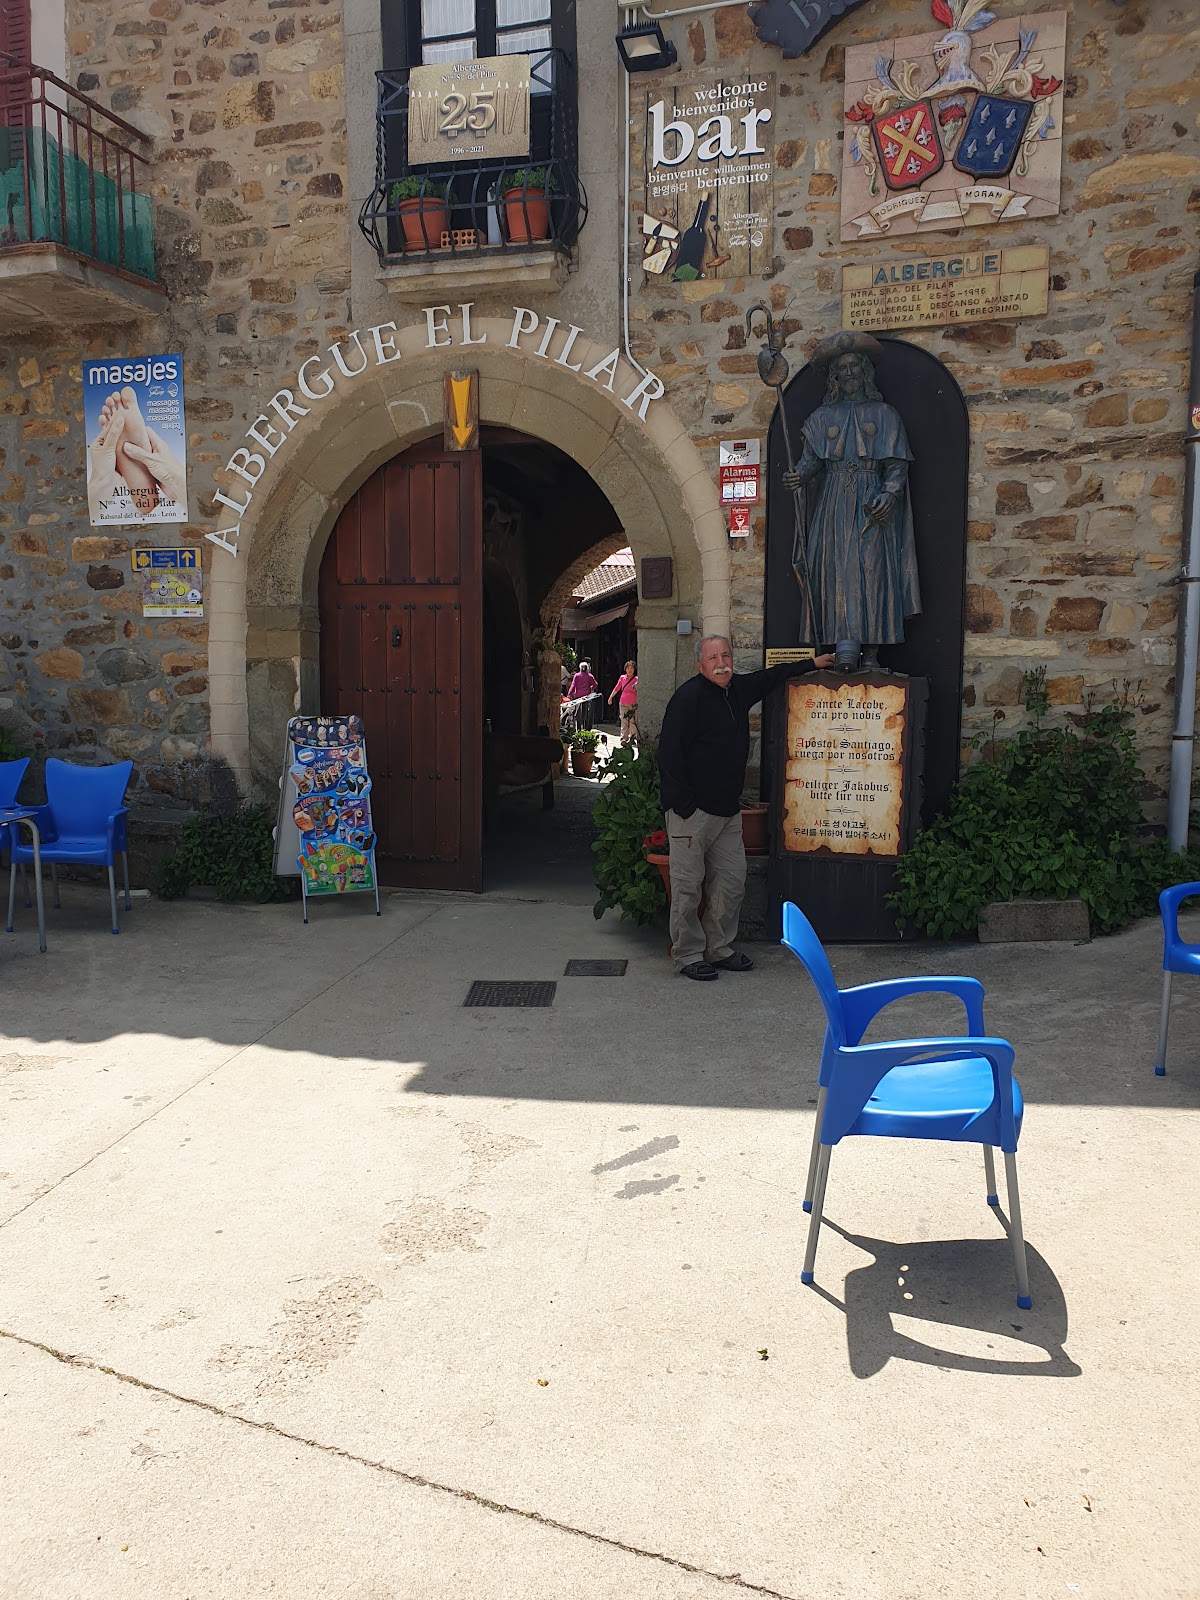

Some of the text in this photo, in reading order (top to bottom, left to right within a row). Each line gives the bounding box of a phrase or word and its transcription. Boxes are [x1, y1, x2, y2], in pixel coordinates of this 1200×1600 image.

[452, 64, 486, 72] Albergue
[694, 81, 767, 101] welcome
[440, 91, 496, 132] 25
[673, 98, 754, 118] bienvenidos
[648, 100, 772, 169] bar
[648, 167, 709, 183] bienvenue
[714, 163, 771, 175] willkommen
[697, 172, 768, 189] benvenuto
[652, 182, 688, 197] 환영하다
[875, 196, 926, 219] RODRIGUEZ
[874, 255, 998, 285] ALBERGUE
[927, 282, 954, 291] PILAR
[851, 293, 1029, 318] ESTE ALBERGUE DESCANSO AMISTAD
[860, 315, 914, 326] ESPERANZA
[89, 358, 177, 386] masajes
[204, 302, 665, 558] ALBERGUE EL PILAR
[723, 468, 756, 477] Alarma
[112, 486, 160, 499] Albergue
[136, 499, 150, 508] del
[154, 498, 175, 508] Pilar
[805, 699, 842, 709] Sancte
[832, 712, 848, 720] pro
[852, 711, 881, 720] nobis
[840, 739, 894, 751] Santiago,
[795, 751, 895, 760] ruega por nosotros
[842, 780, 892, 793] Jakobus,
[810, 790, 832, 800] bitte
[856, 793, 875, 802] uns
[832, 820, 840, 828] 성
[793, 828, 817, 836] 우리를
[819, 829, 842, 838] 위하여
